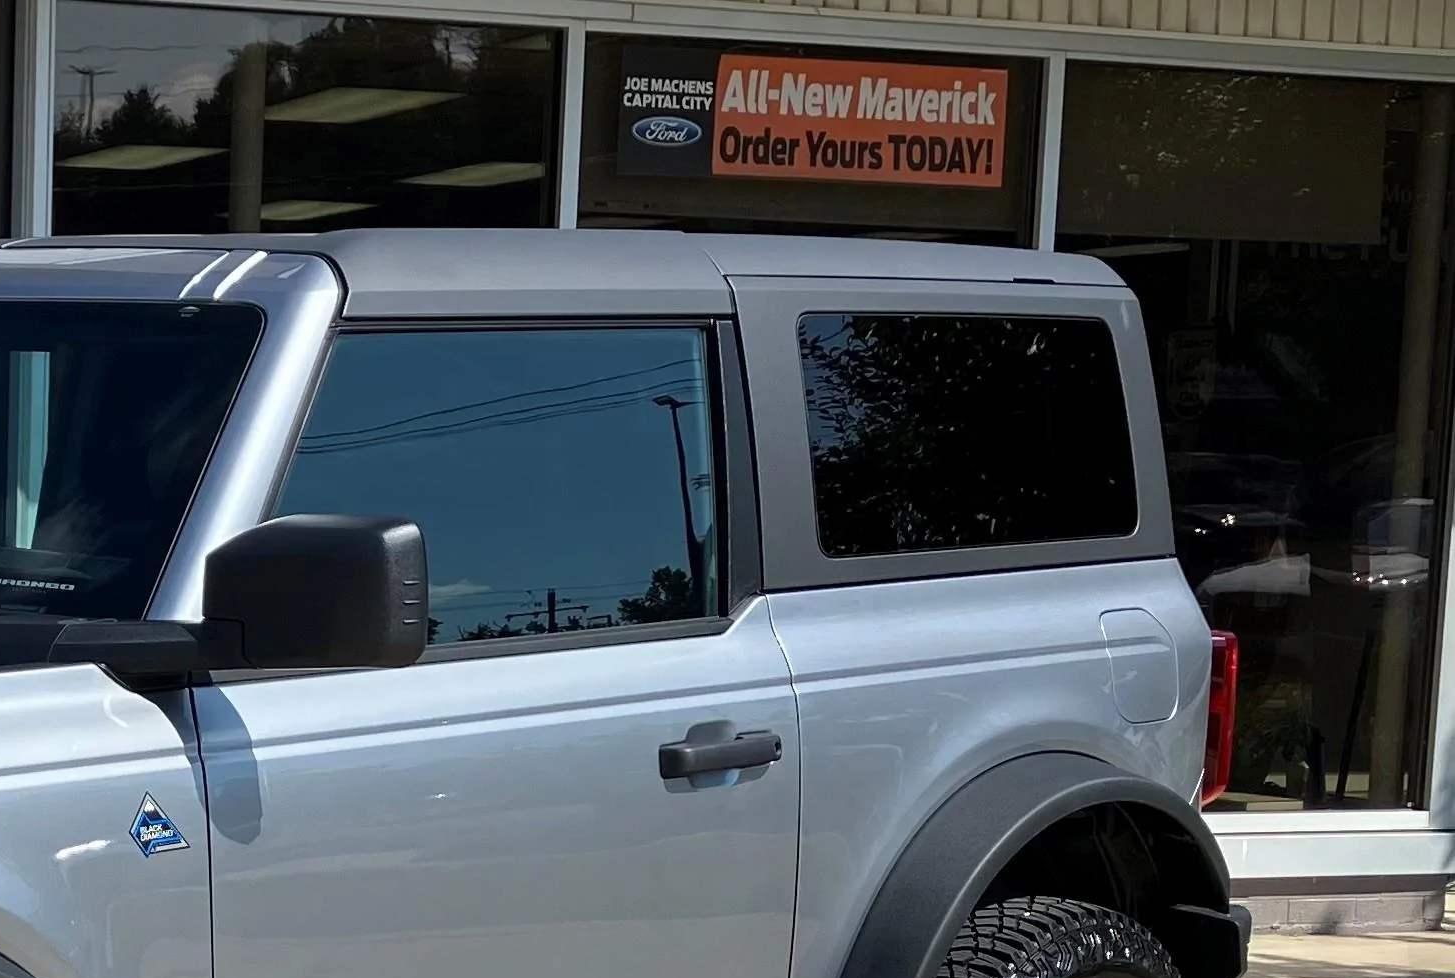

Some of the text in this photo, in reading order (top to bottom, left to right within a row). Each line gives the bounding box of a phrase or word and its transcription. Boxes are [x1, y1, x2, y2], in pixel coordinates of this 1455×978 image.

[625, 77, 714, 95] JOE MACHENS
[623, 92, 713, 111] CAPITAL CITY
[720, 69, 997, 125] All-New Maverick
[645, 120, 690, 142] Ford
[719, 126, 995, 176] Order Yours TODAY!
[139, 823, 163, 835] BLACK
